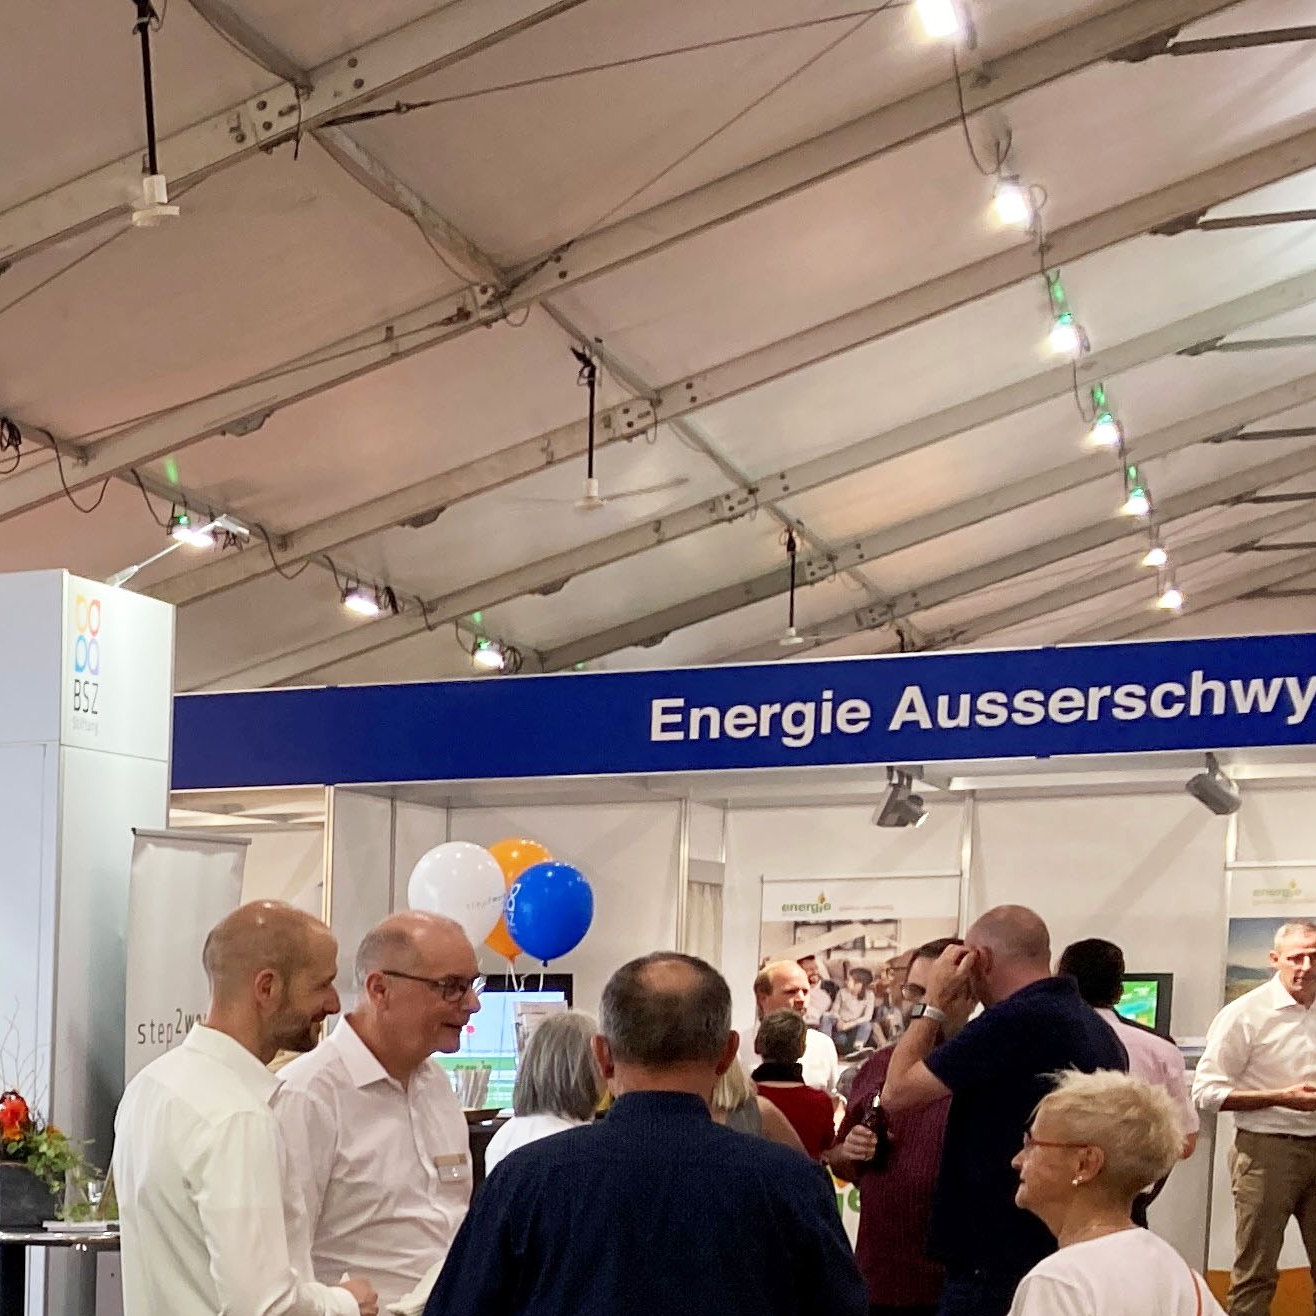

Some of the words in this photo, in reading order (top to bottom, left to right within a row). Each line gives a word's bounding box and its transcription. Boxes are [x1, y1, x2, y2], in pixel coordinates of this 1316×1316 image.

[73, 679, 99, 715] BSZ
[649, 690, 872, 748] Energie
[888, 671, 1316, 732] Ausserschwy
